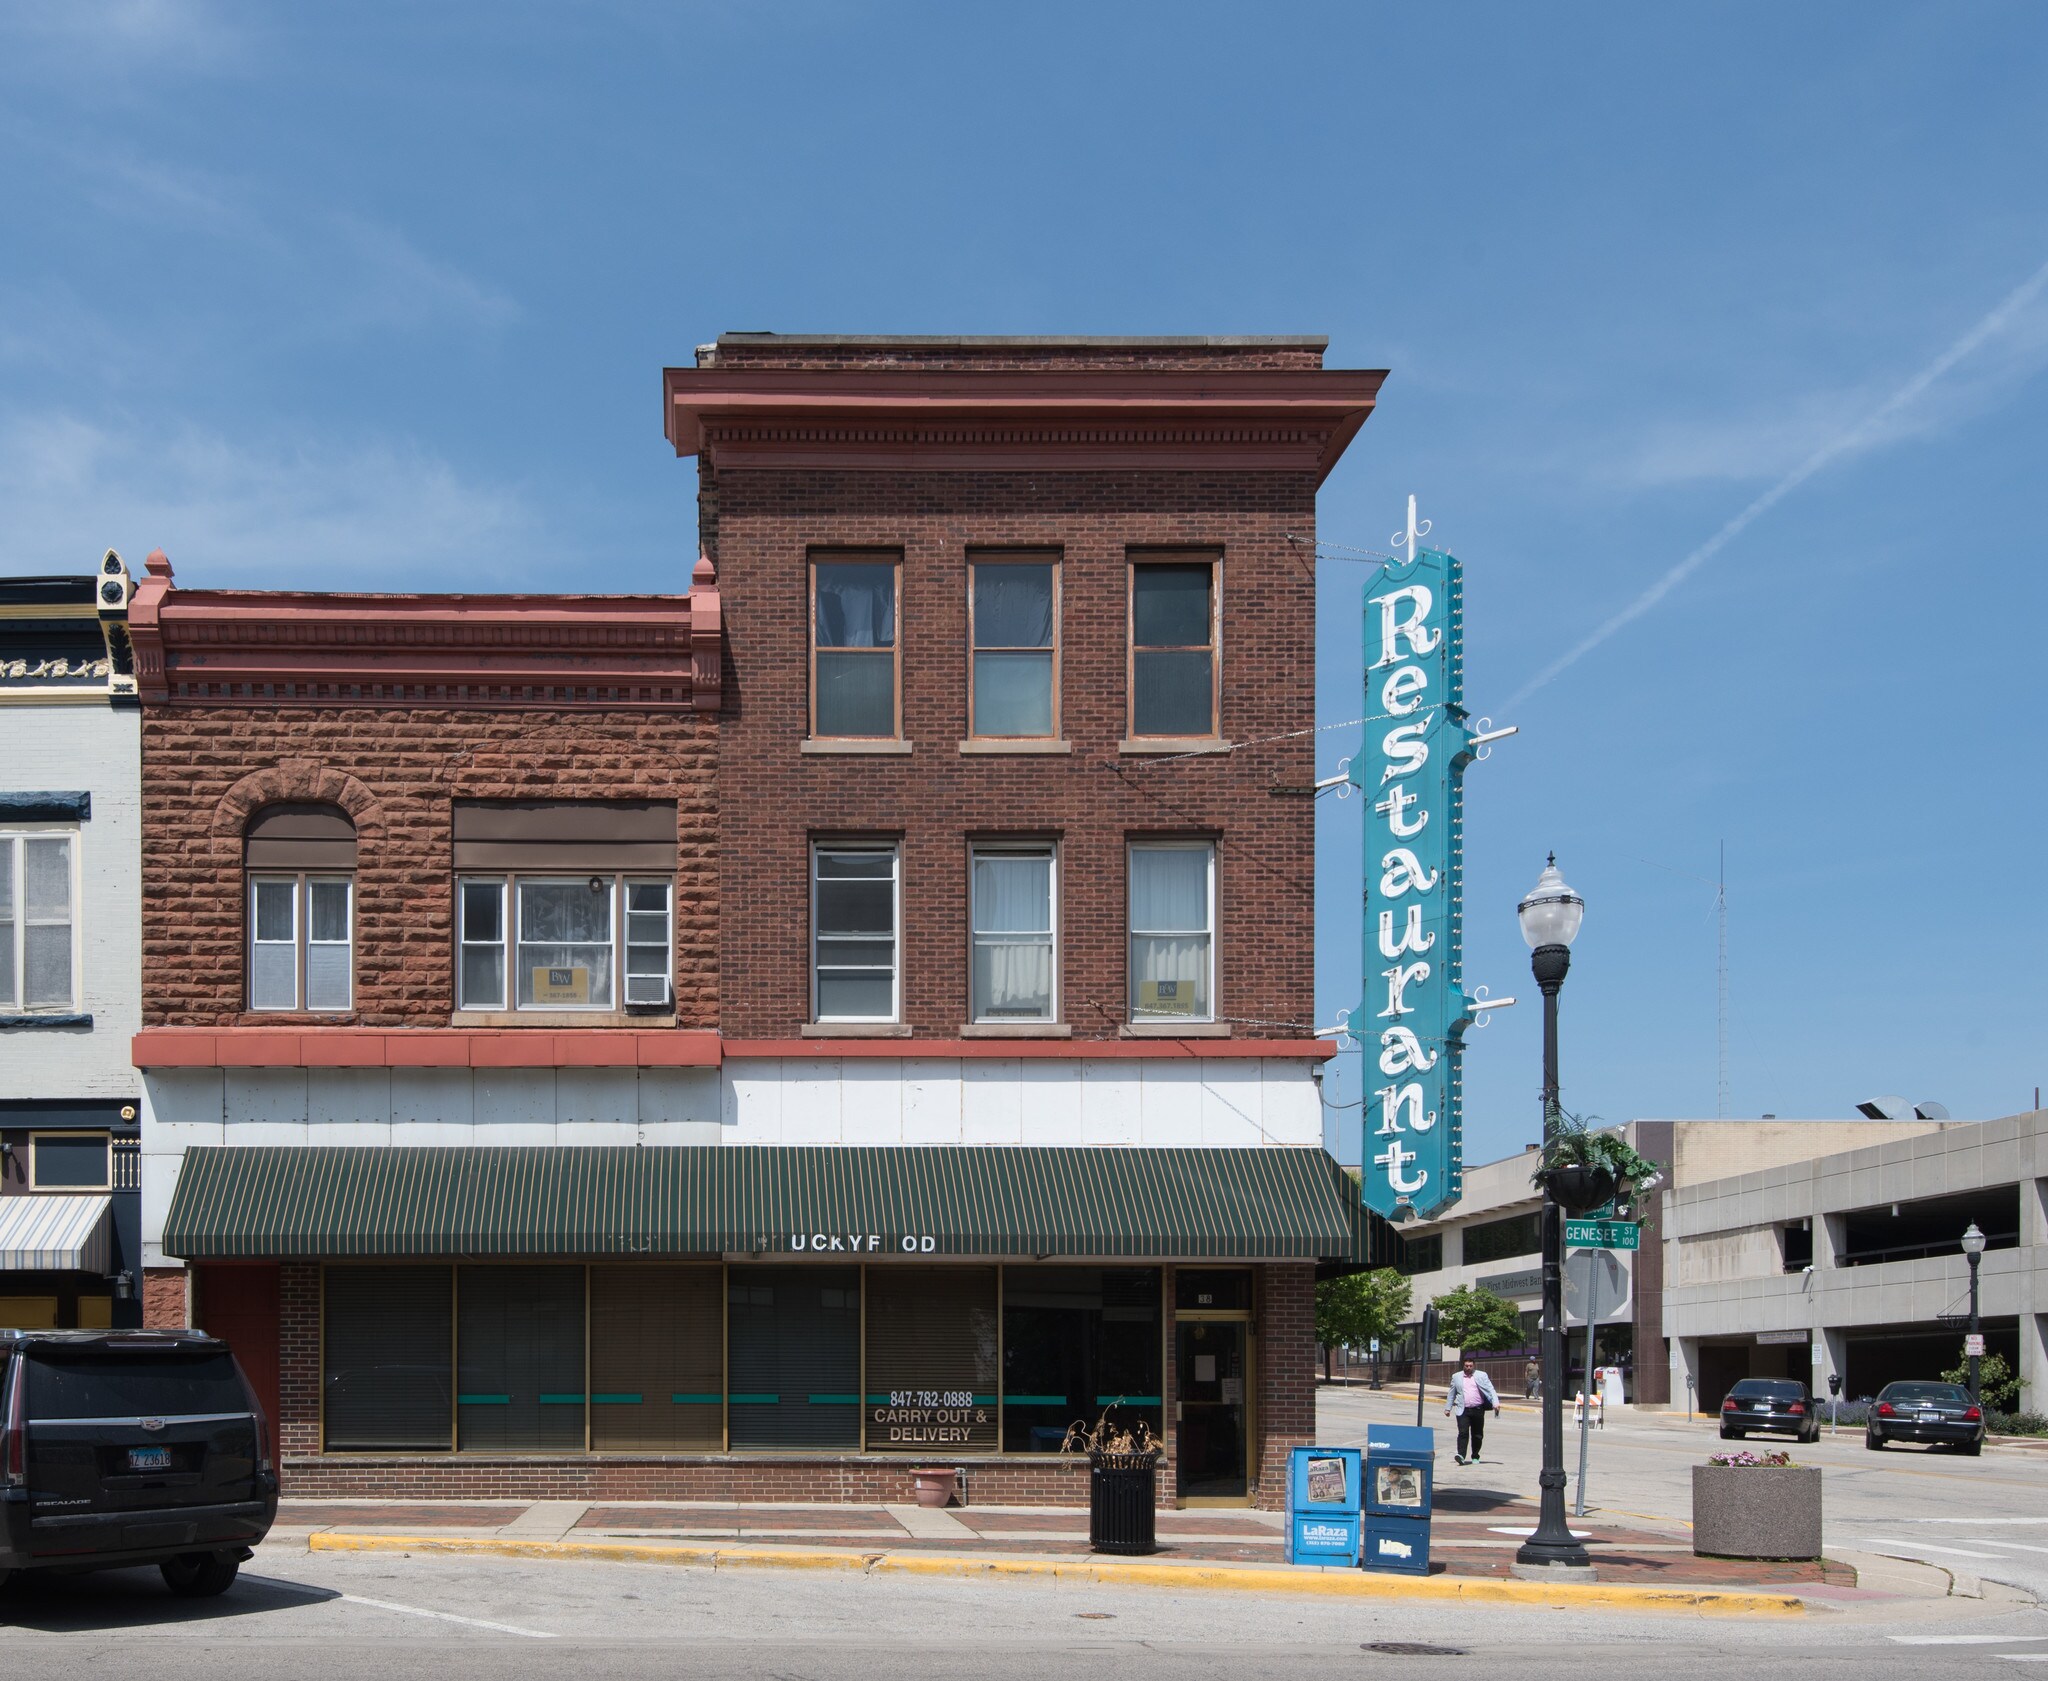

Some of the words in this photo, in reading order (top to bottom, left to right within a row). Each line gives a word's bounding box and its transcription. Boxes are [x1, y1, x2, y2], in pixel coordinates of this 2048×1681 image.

[1367, 584, 1442, 1193] Restaurant
[1566, 1226, 1618, 1242] GENESEE
[1624, 1226, 1634, 1235] ST
[1622, 1237, 1635, 1246] 100
[1487, 1280, 1501, 1292] First
[1502, 1277, 1529, 1290] Midwest
[1529, 1275, 1542, 1287] Ban
[890, 1390, 973, 1407] 847-782-0888
[874, 1408, 932, 1423] CARRY
[936, 1409, 972, 1423] OUT
[975, 1409, 987, 1423] &
[890, 1427, 972, 1441] DELIVERY
[143, 1453, 170, 1466] 23618
[1309, 1465, 1329, 1473] aRaza
[36, 1499, 92, 1507] ESCALADE
[1303, 1524, 1348, 1537] LaRaza
